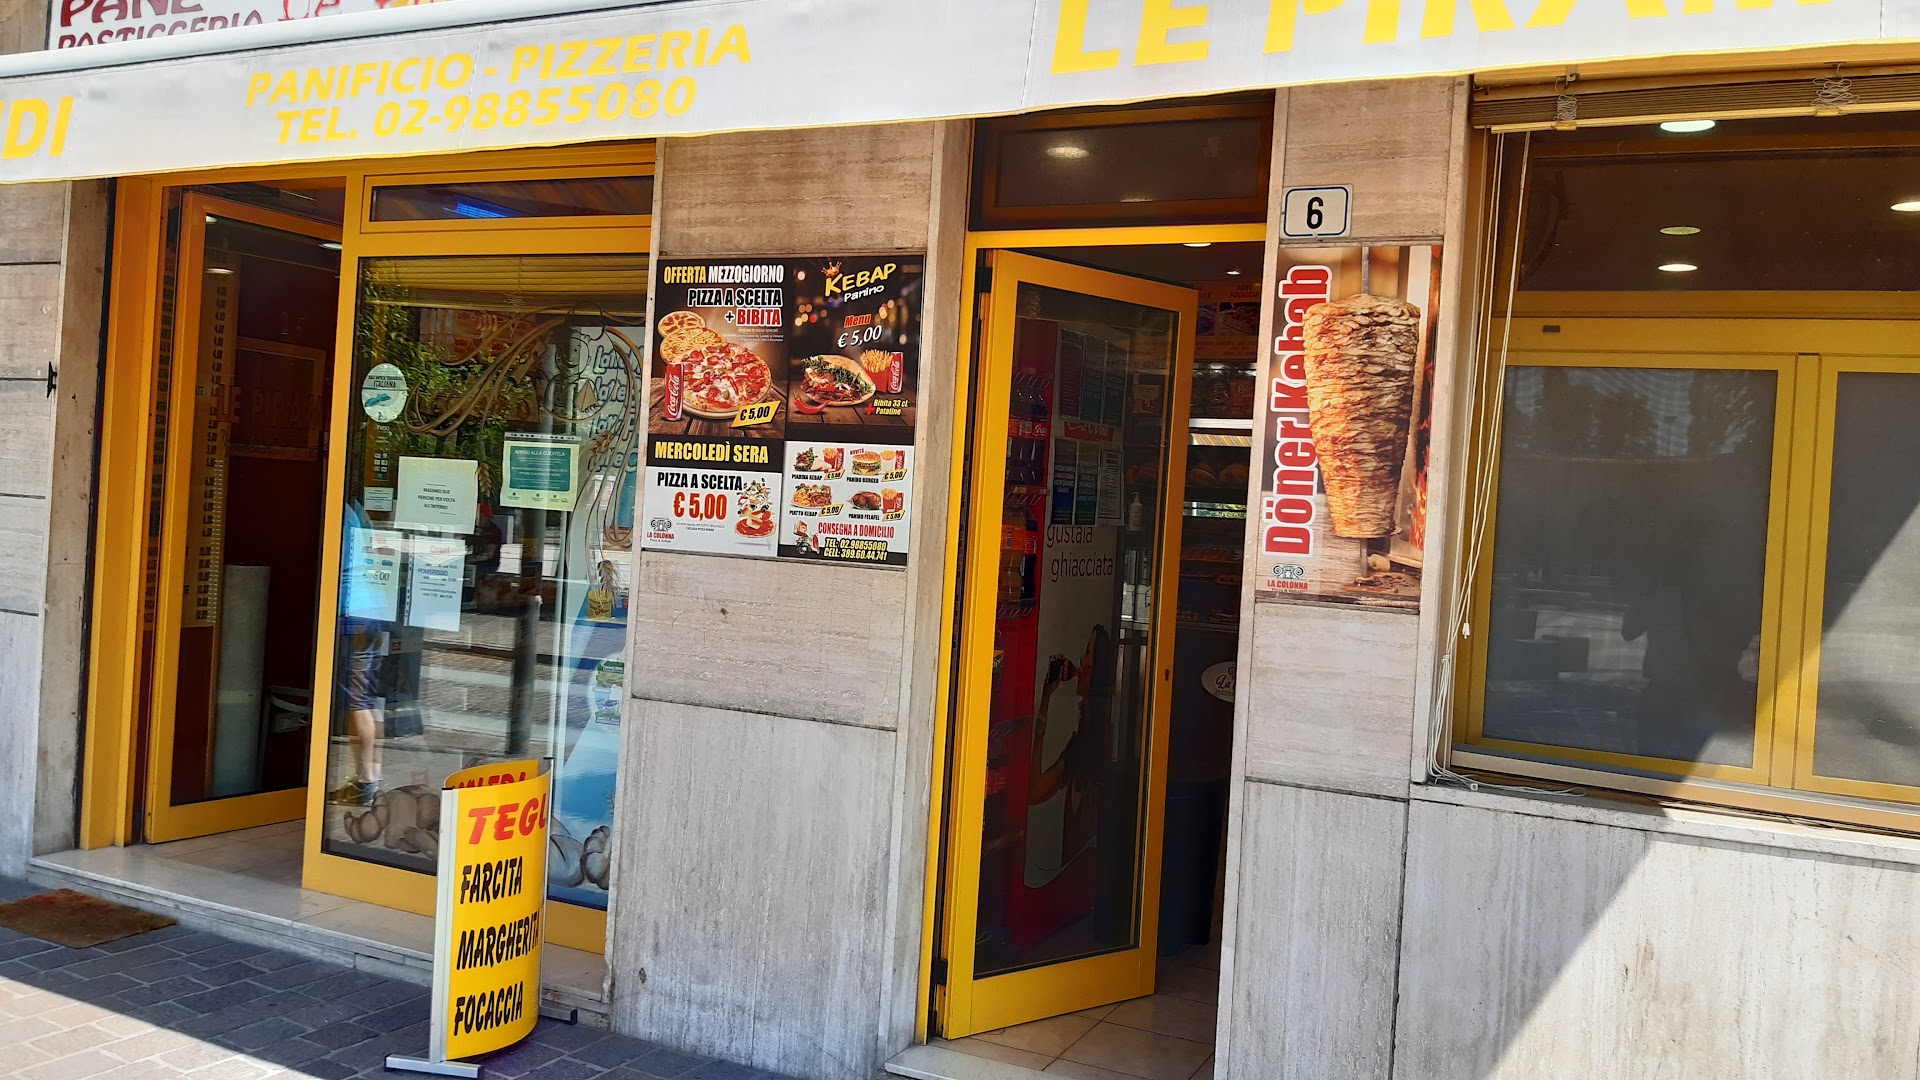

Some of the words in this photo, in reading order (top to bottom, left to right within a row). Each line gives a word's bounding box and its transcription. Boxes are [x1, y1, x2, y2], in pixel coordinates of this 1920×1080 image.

[245, 52, 473, 107] PANIFICIO
[509, 24, 752, 83] PIZZERIA
[275, 106, 358, 144] TEL.
[373, 76, 697, 137] 02-98855080
[0, 96, 75, 159] DI
[1307, 197, 1323, 229] 6
[664, 266, 706, 284] OFFERTA
[708, 265, 784, 283] MEZZOGIORNO
[825, 263, 896, 297] KEBAP
[688, 289, 722, 306] PIZZA
[725, 289, 734, 306] A
[736, 289, 782, 306] SCELTA
[736, 308, 782, 326] BIBITA
[844, 314, 871, 328] Menu
[837, 333, 848, 347] €
[850, 325, 882, 345] 5,00
[1272, 267, 1330, 410] Kebab
[749, 406, 771, 420] 5,00
[873, 399, 892, 407] Bibita
[892, 399, 901, 407] 33
[654, 441, 730, 462] MERCOLEDÌ
[733, 445, 769, 463] SERA
[657, 472, 688, 487] PIZZA
[690, 474, 698, 488] A
[701, 474, 742, 490] SCELTA
[1264, 419, 1318, 555] Döner
[673, 491, 685, 518] €
[689, 493, 727, 521] 5,00
[818, 522, 852, 535] CONSEGNA
[853, 524, 858, 535] A
[860, 525, 894, 538] DOMICILIO
[824, 548, 840, 557] CELL:
[825, 538, 838, 547] TEL:
[1051, 552, 1113, 583] ghiacciata
[1277, 580, 1308, 590] COLONNA
[460, 856, 522, 904] FARCITA
[454, 980, 524, 1036] FOCACCIA
